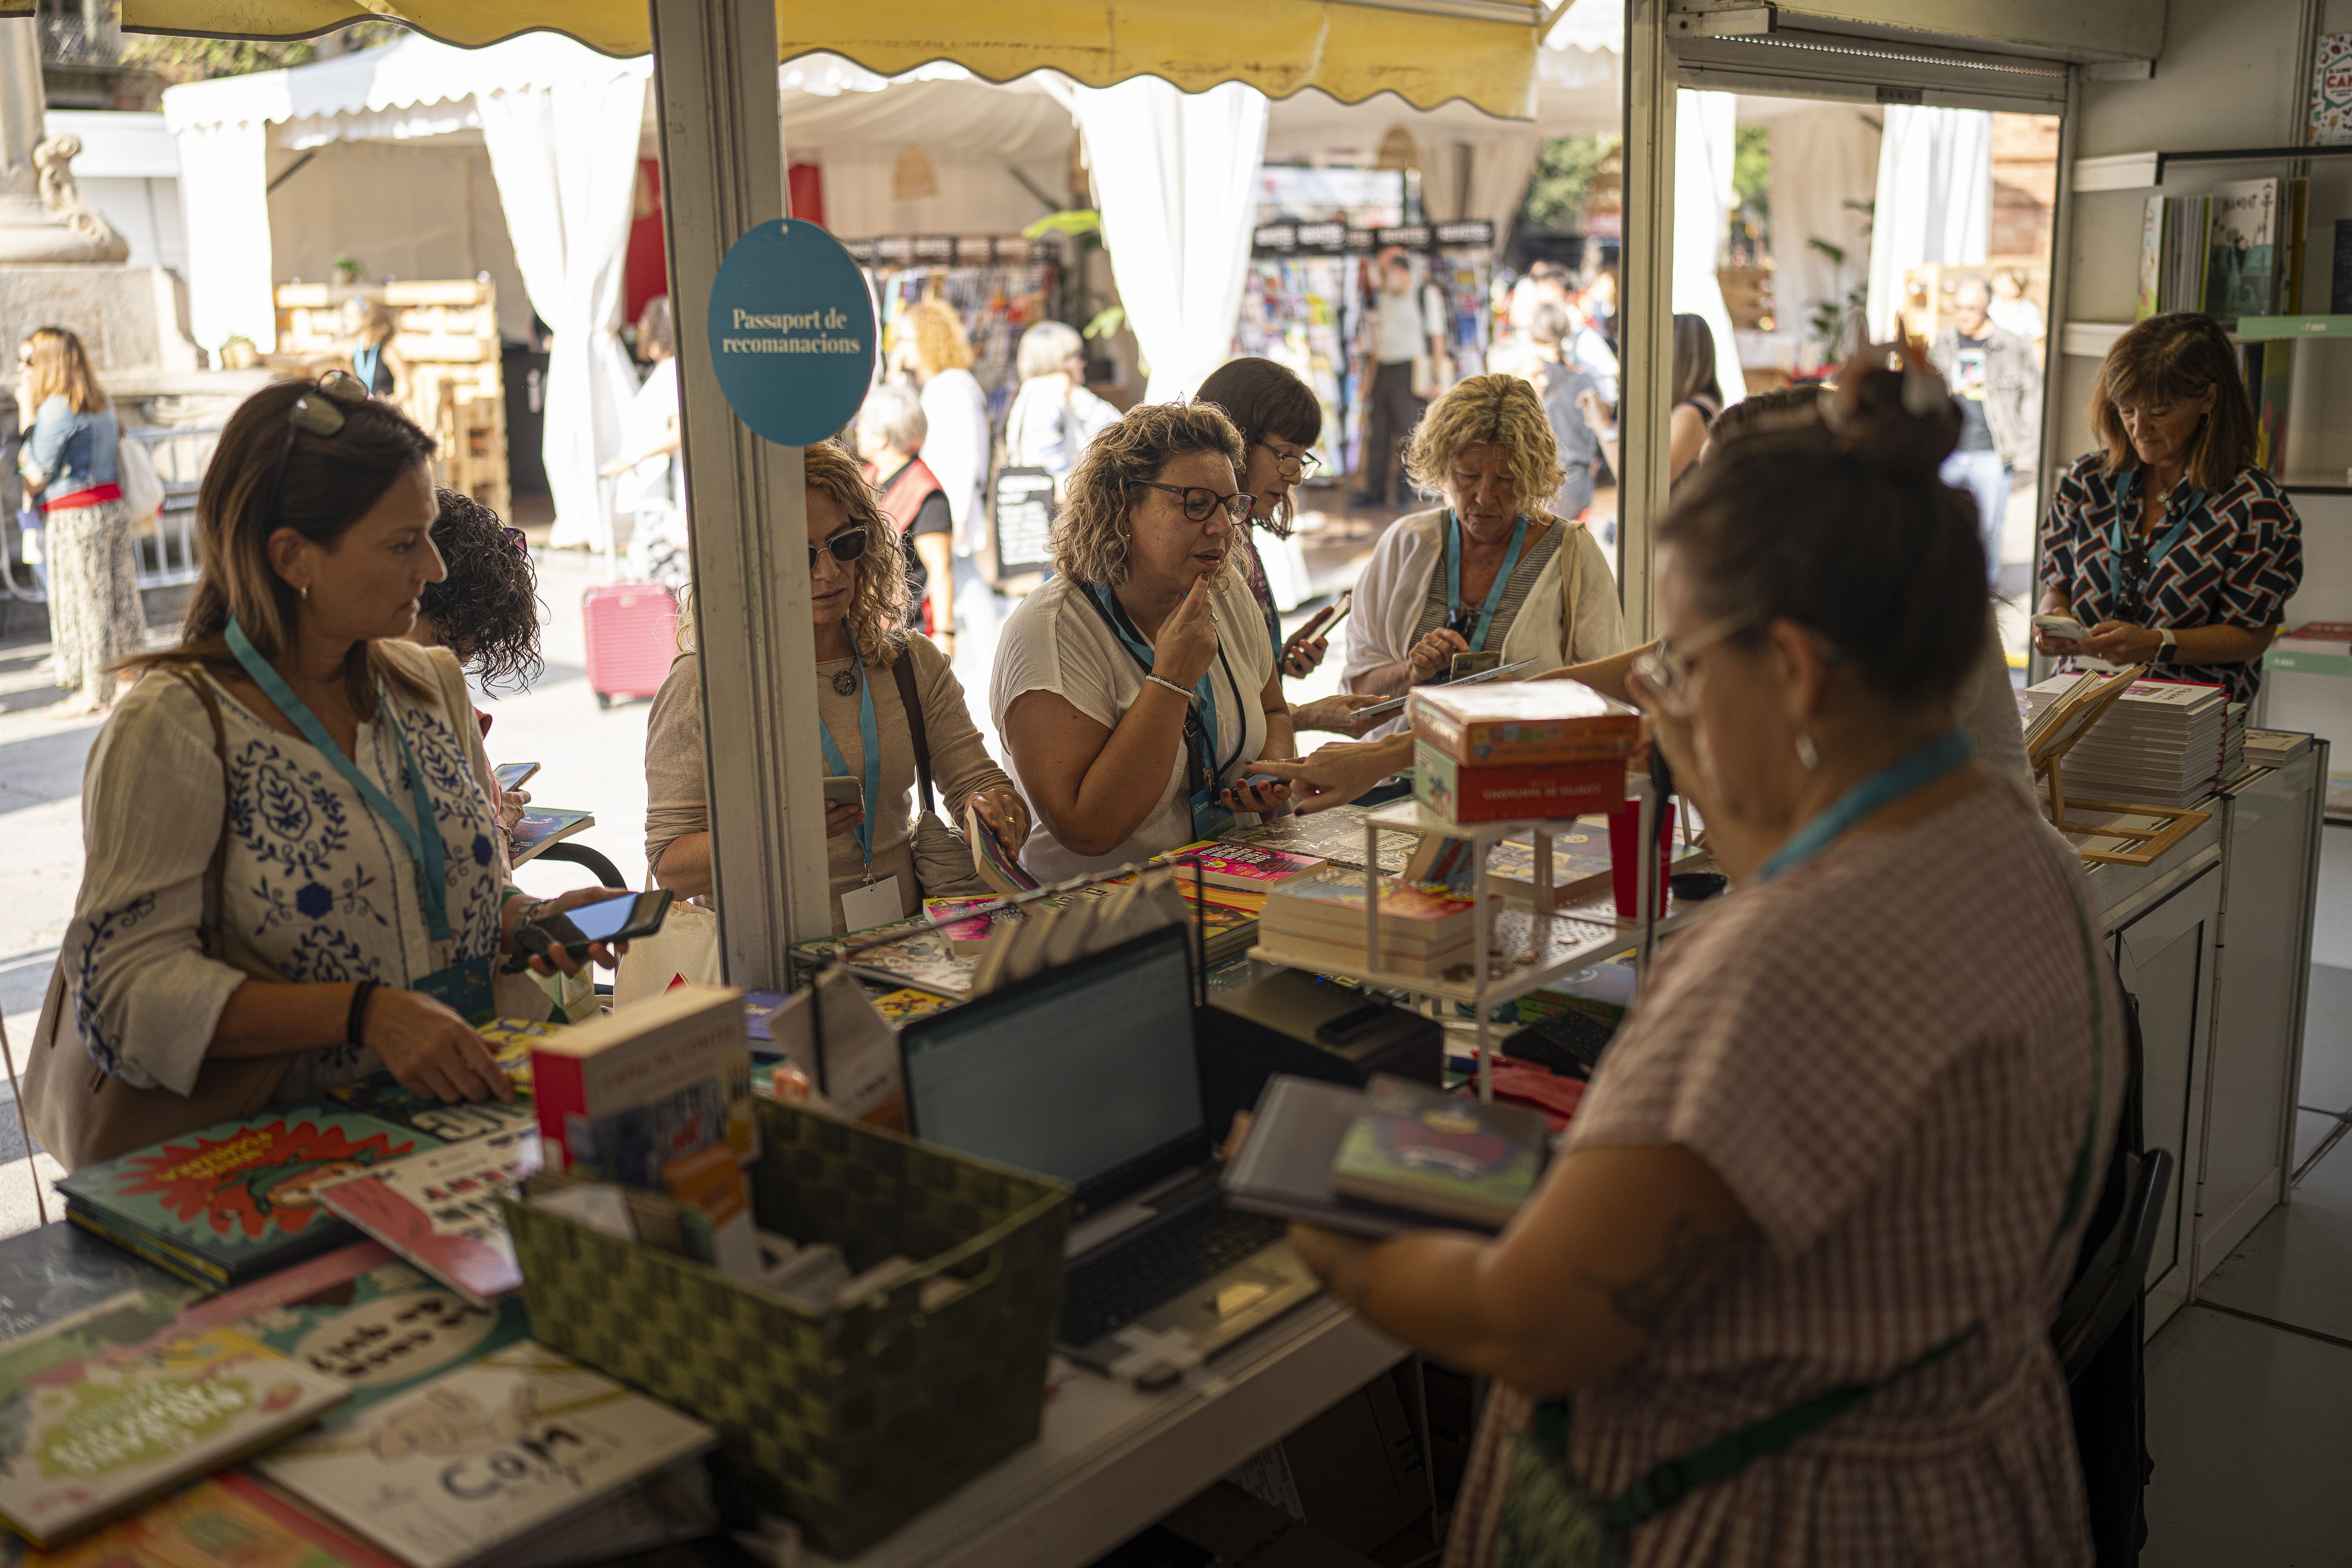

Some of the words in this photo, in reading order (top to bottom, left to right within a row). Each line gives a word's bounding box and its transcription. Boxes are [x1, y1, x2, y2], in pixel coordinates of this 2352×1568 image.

[733, 309, 821, 334] Passaport
[824, 307, 847, 329] de
[723, 333, 861, 354] recomanacions
